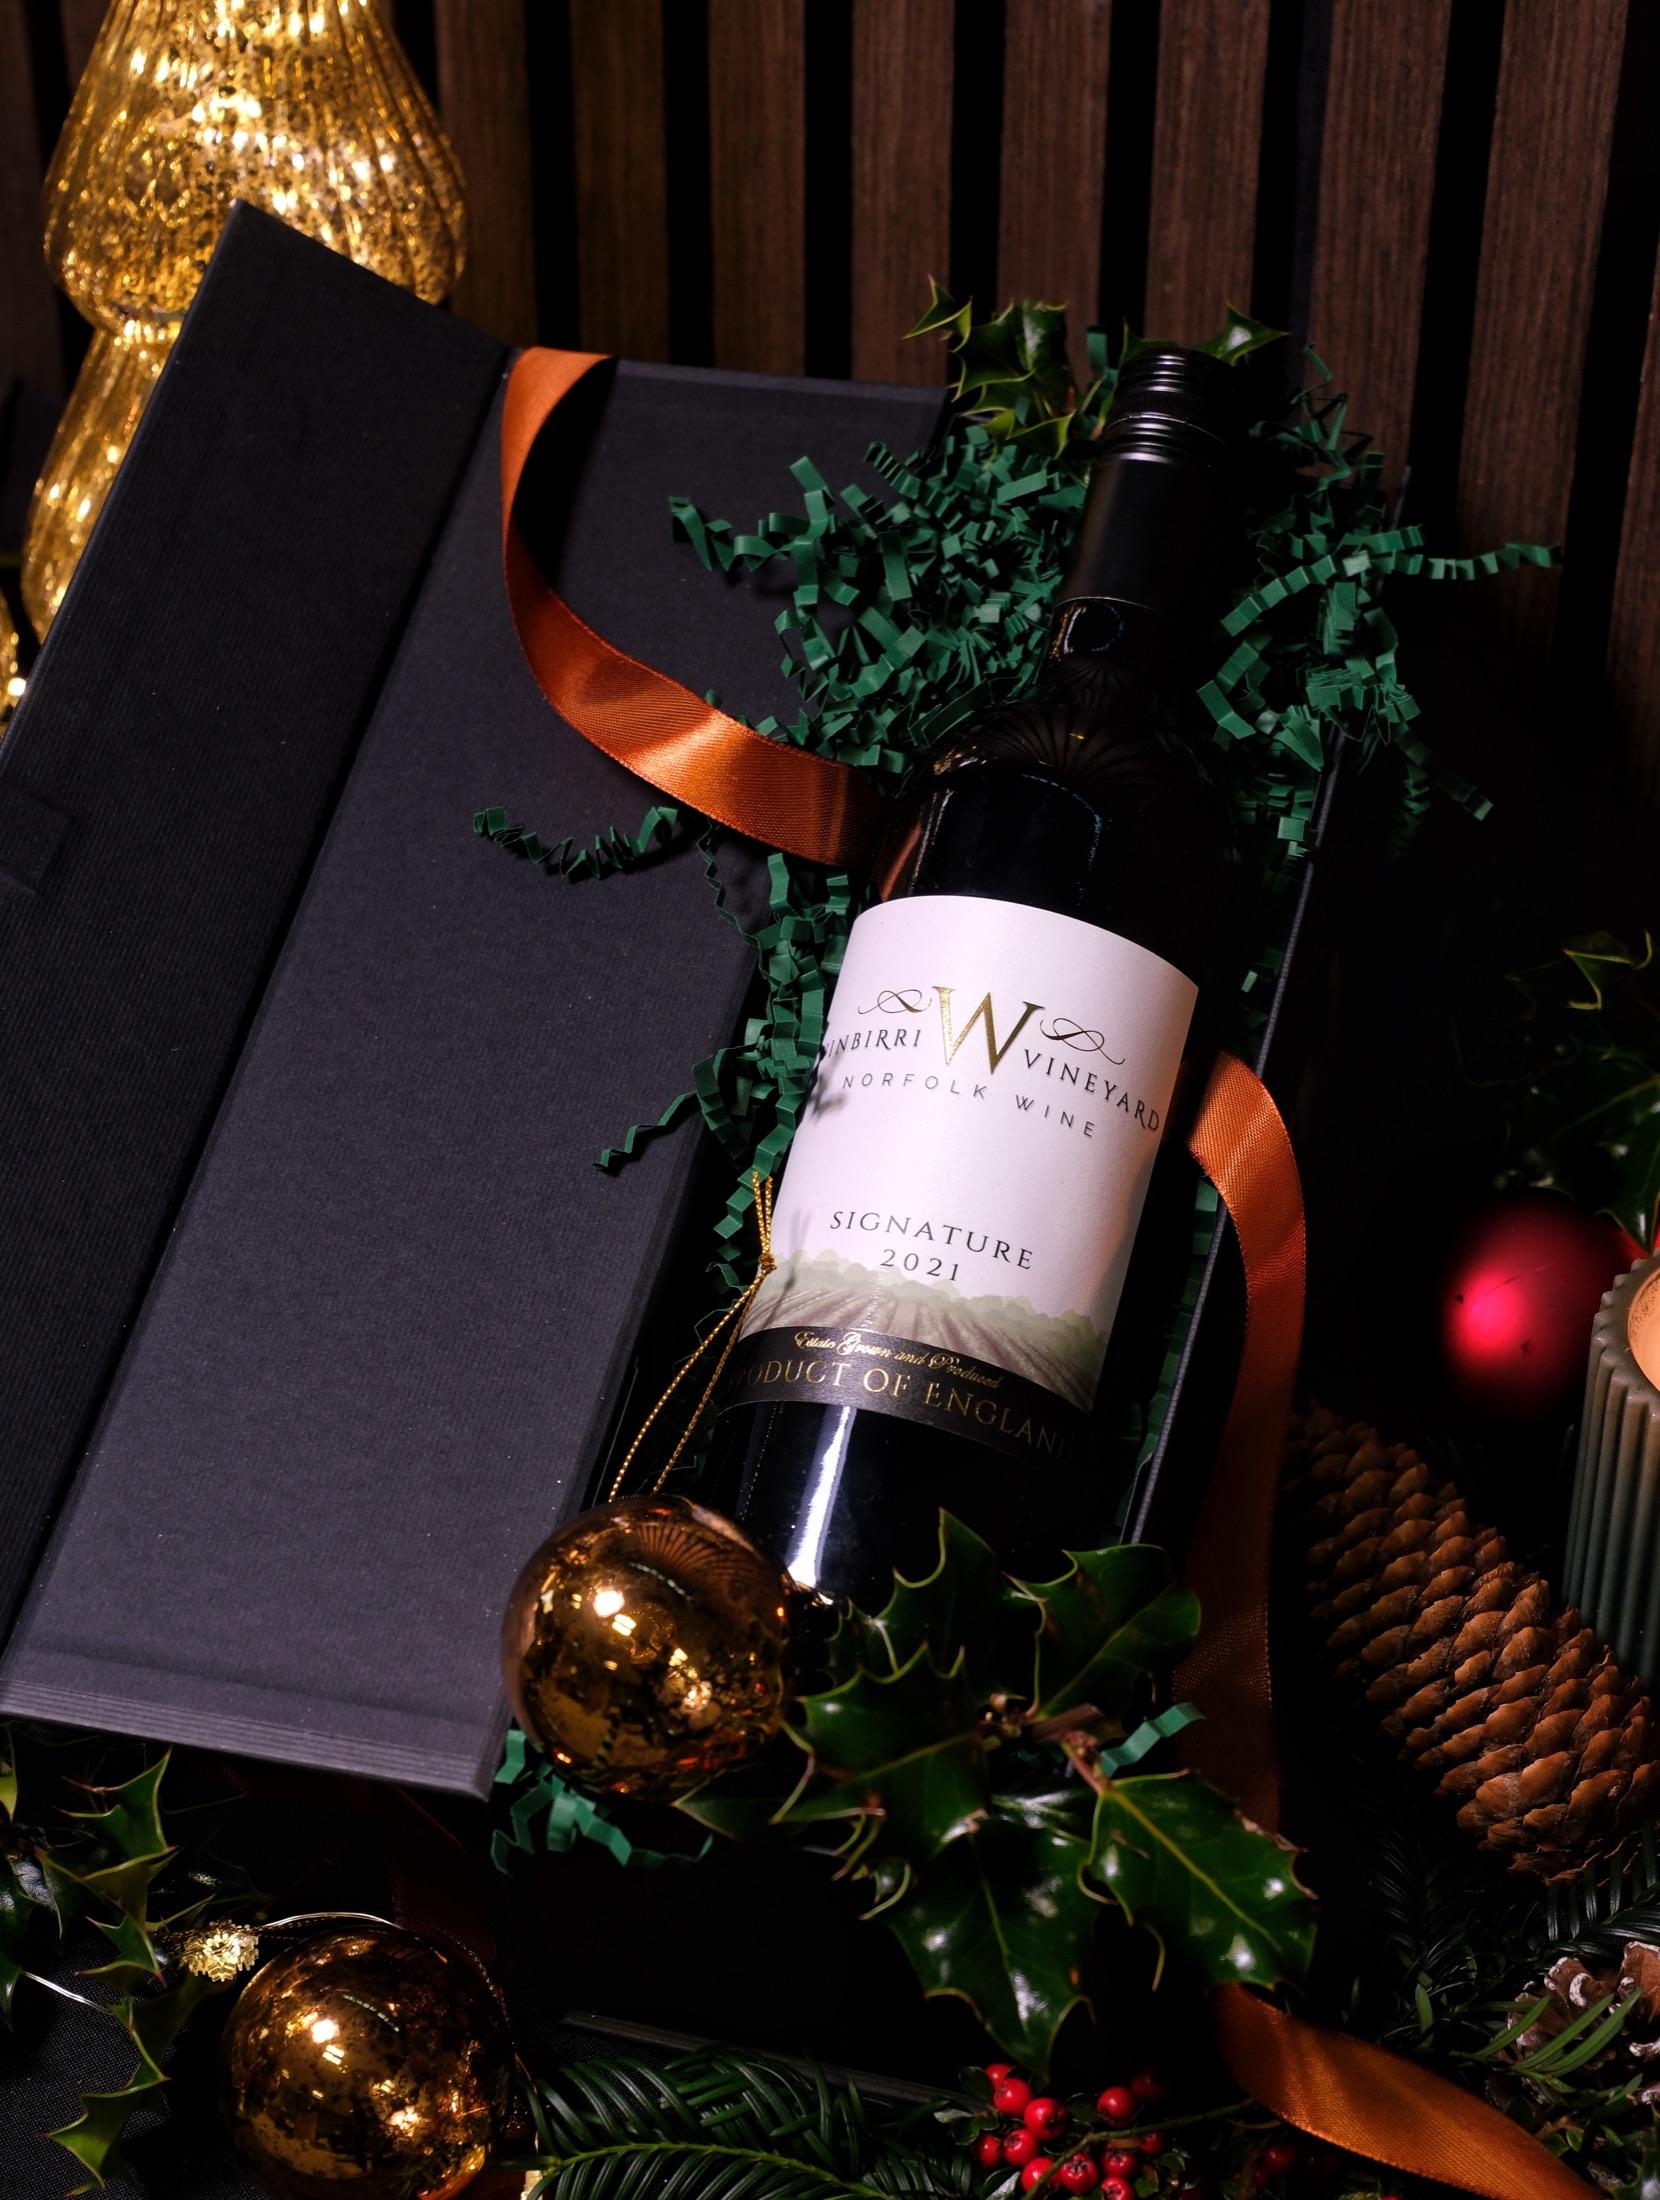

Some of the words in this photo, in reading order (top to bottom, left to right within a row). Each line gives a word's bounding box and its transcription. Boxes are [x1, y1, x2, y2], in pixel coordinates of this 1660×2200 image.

[930, 985, 1046, 1075] W
[824, 1028, 922, 1057] INBIRRI
[1023, 1049, 1160, 1132] VINEYARD
[842, 1072, 988, 1100] NORFOLK
[1014, 1093, 1097, 1138] WINE
[829, 1210, 1034, 1270] SIGNATURE
[880, 1248, 959, 1282] 2021
[793, 1330, 835, 1351] Estate
[836, 1331, 893, 1359] Grown
[894, 1351, 930, 1366] and
[927, 1352, 1006, 1390] Produced
[862, 1368, 912, 1398] OF
